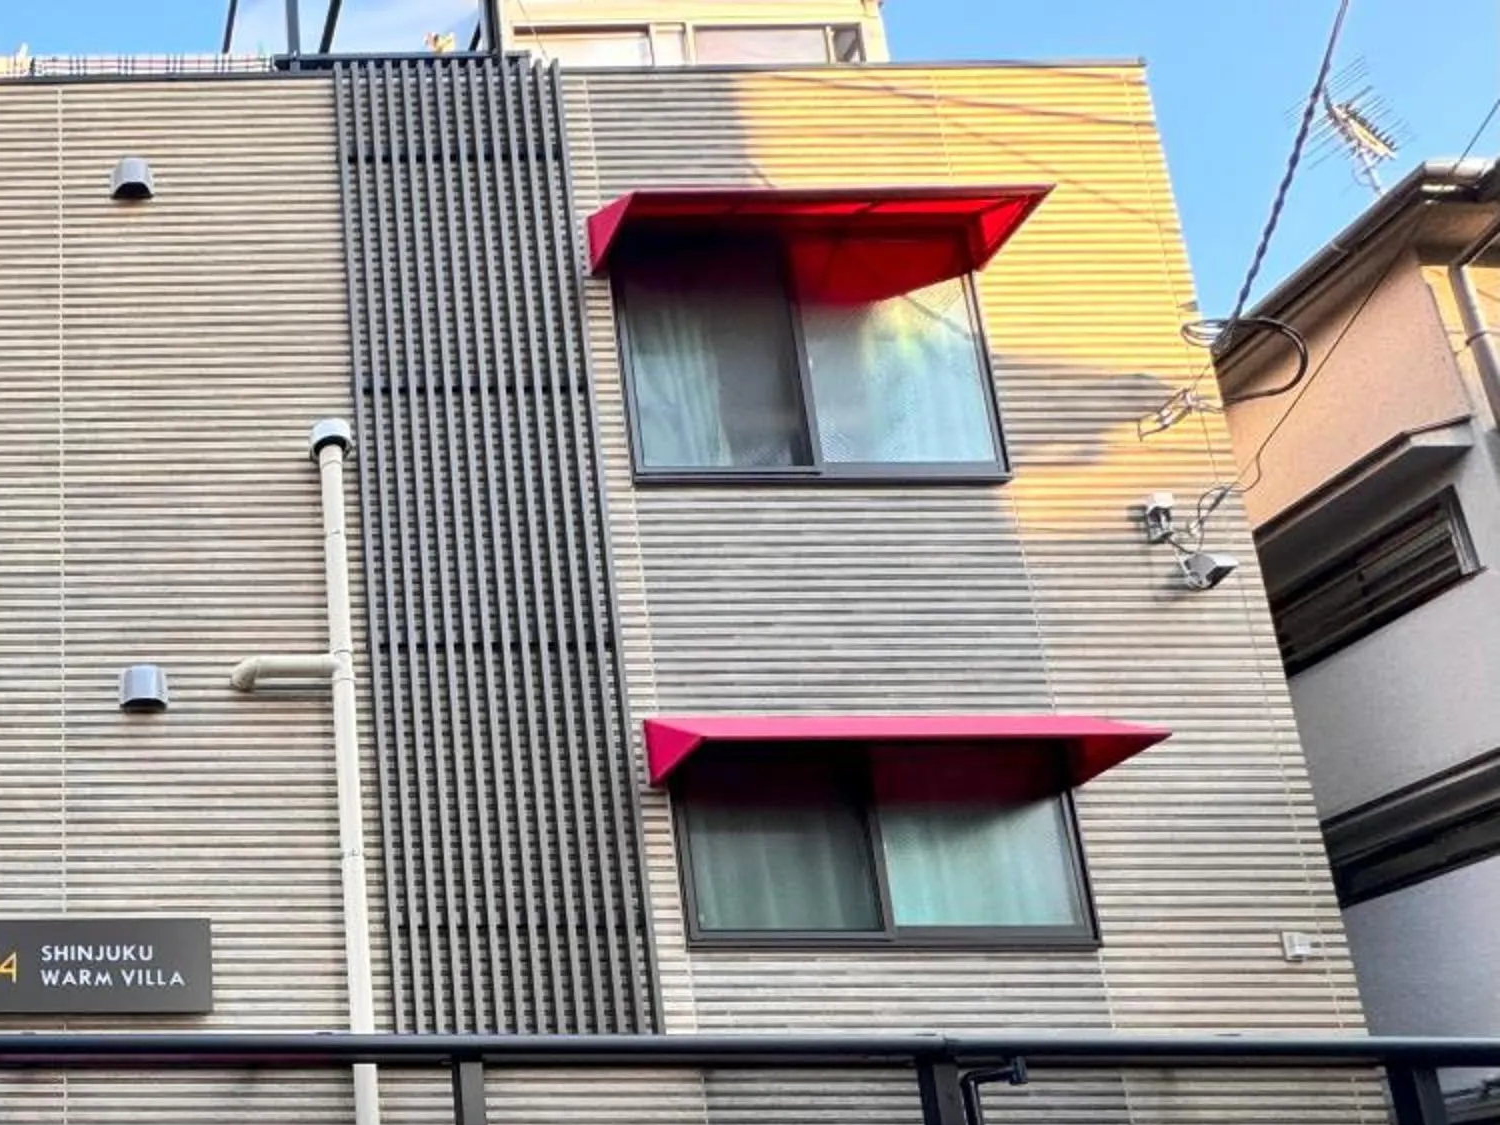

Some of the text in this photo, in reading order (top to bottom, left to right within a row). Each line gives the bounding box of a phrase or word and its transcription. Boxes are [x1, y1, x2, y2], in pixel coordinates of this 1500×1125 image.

[40, 945, 153, 961] SHINJUKU
[40, 968, 186, 986] WARM VILLA
